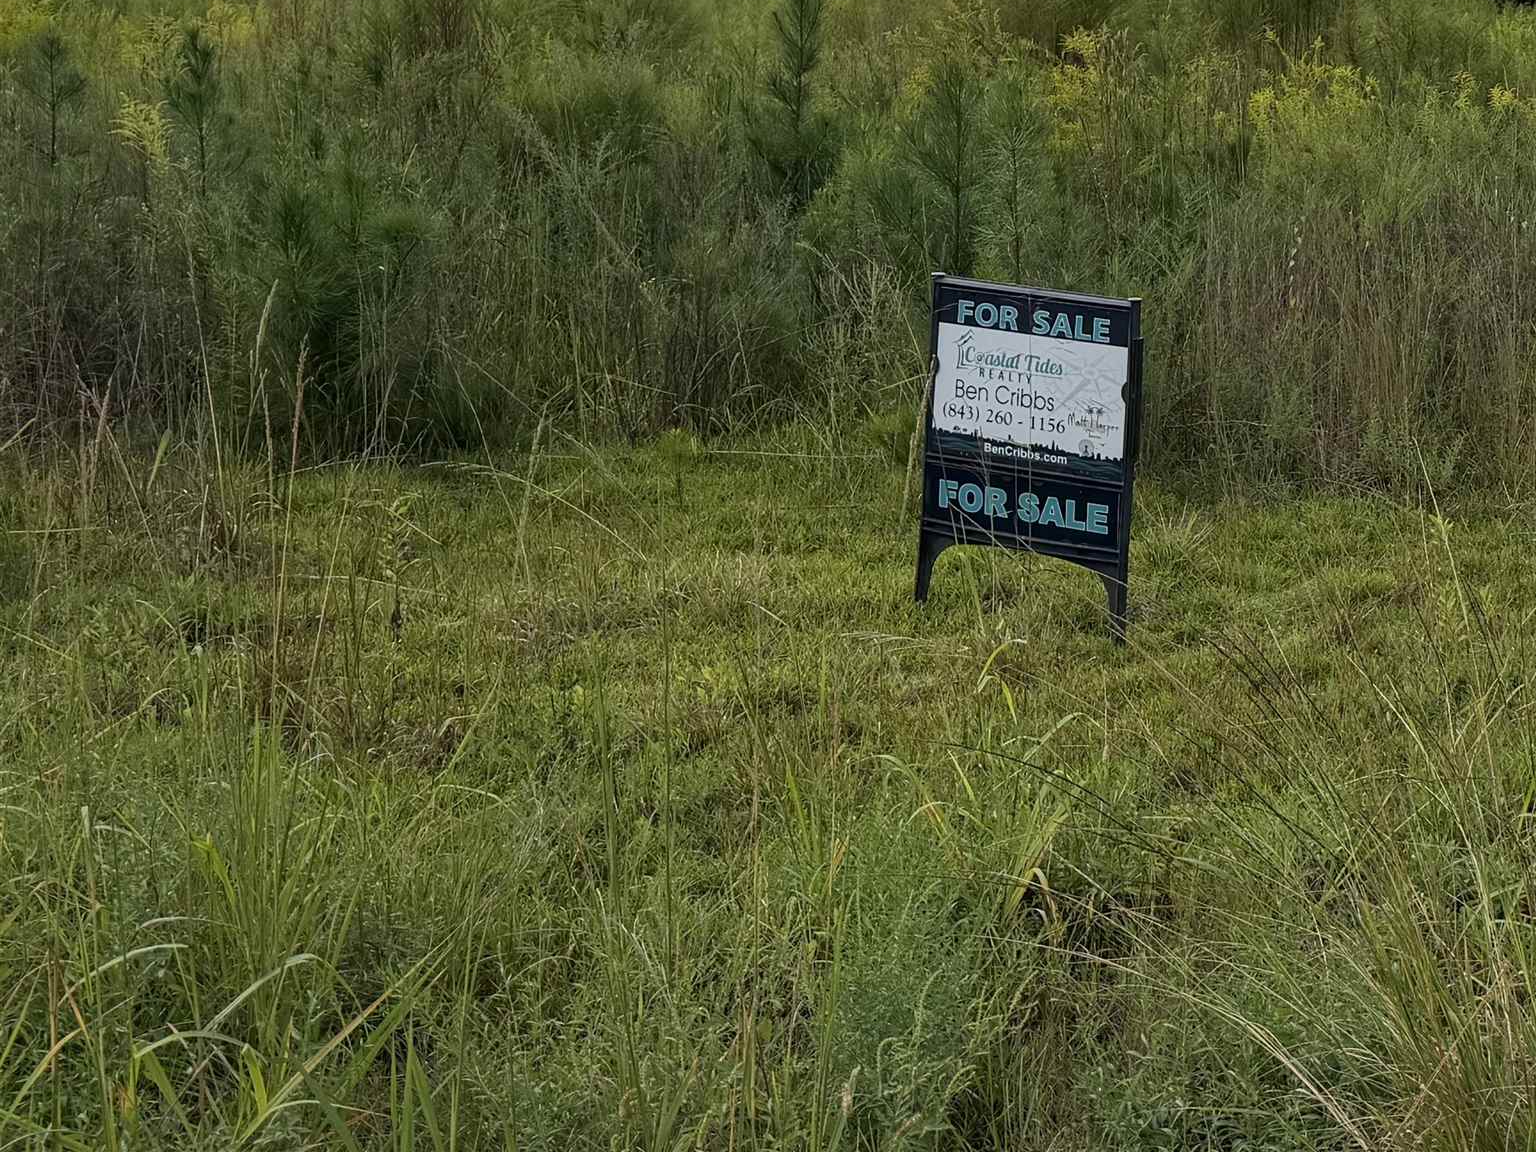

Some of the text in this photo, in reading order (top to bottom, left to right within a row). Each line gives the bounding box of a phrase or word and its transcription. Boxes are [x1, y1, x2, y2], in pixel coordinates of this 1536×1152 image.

[957, 299, 1110, 343] FOR SALE
[964, 346, 1063, 376] Coastal Tides
[979, 367, 1032, 384] REALTY
[955, 378, 1055, 411] Ben Cribbs
[942, 402, 980, 423] (843)
[986, 408, 1013, 426] 260
[1030, 415, 1066, 434] 1156
[983, 442, 1068, 465] BenCribbs.com
[938, 479, 1109, 535] FOR SALE
